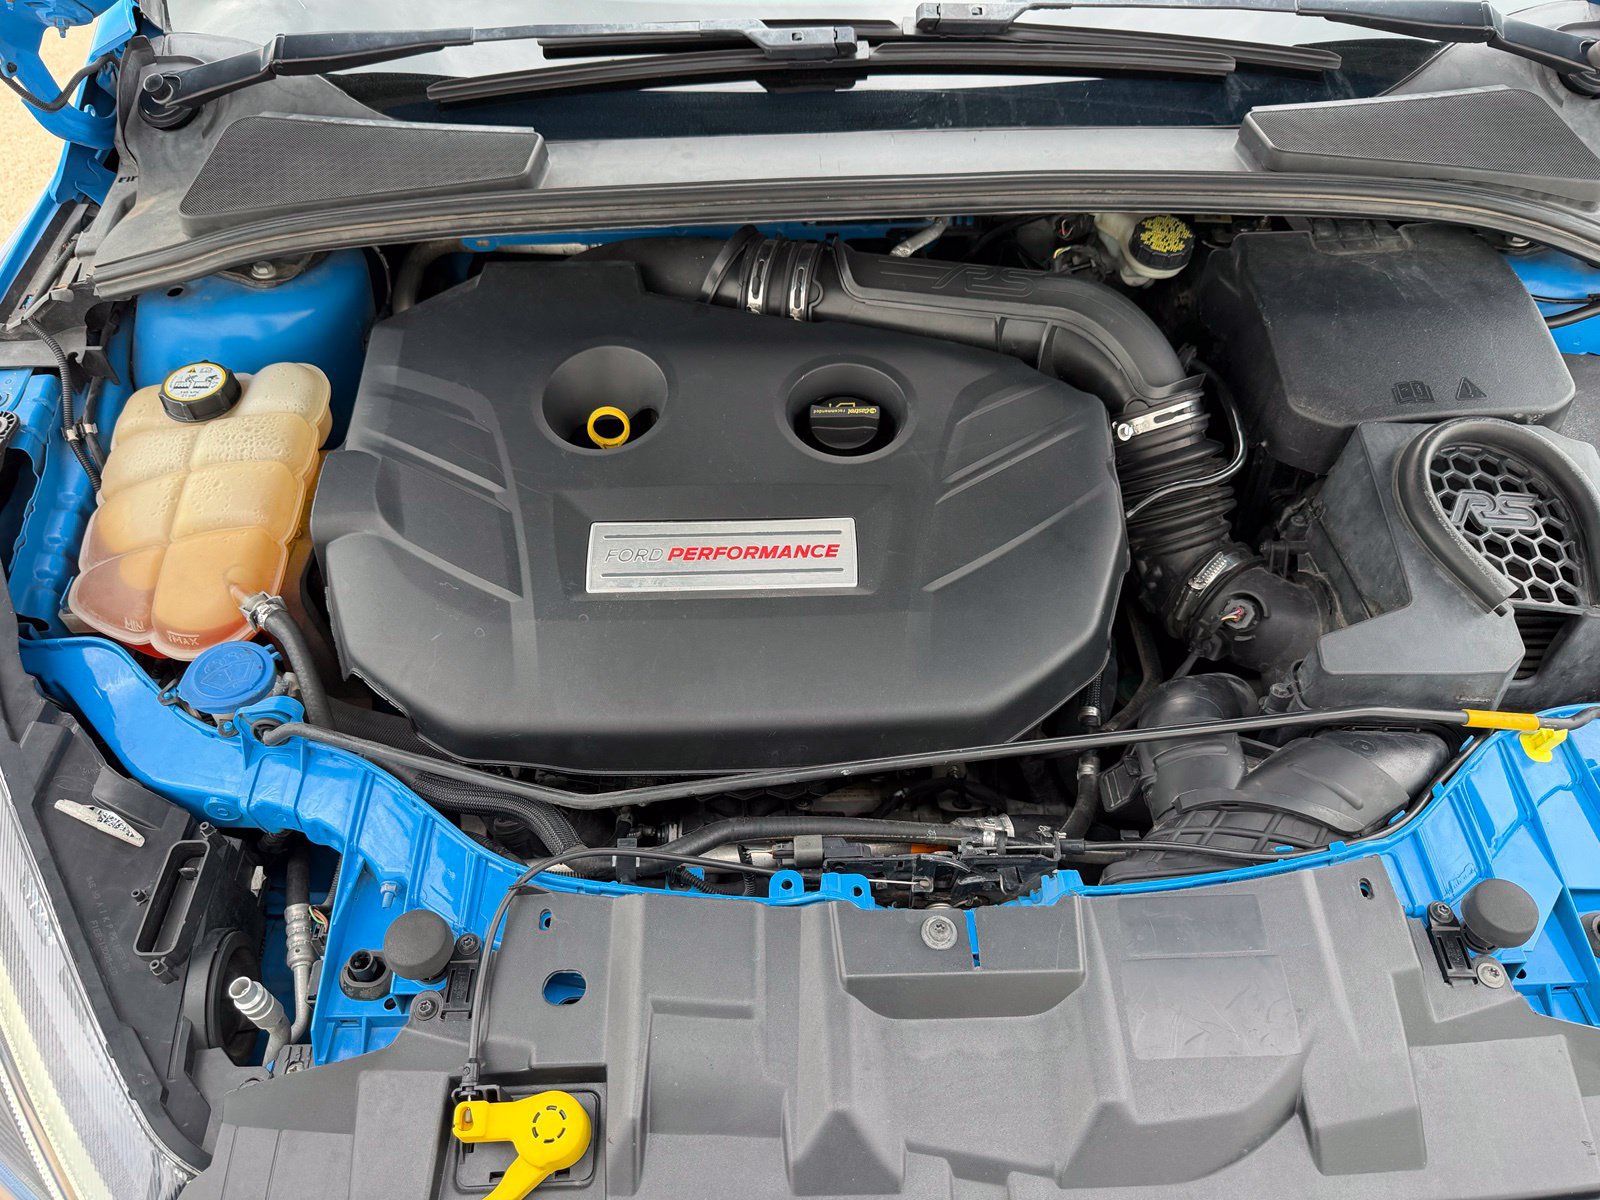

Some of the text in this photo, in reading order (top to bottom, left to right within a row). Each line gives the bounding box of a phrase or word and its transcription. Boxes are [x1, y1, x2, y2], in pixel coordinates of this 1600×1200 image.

[1450, 488, 1540, 531] RS
[604, 543, 841, 563] FORD PERFORMANCE
